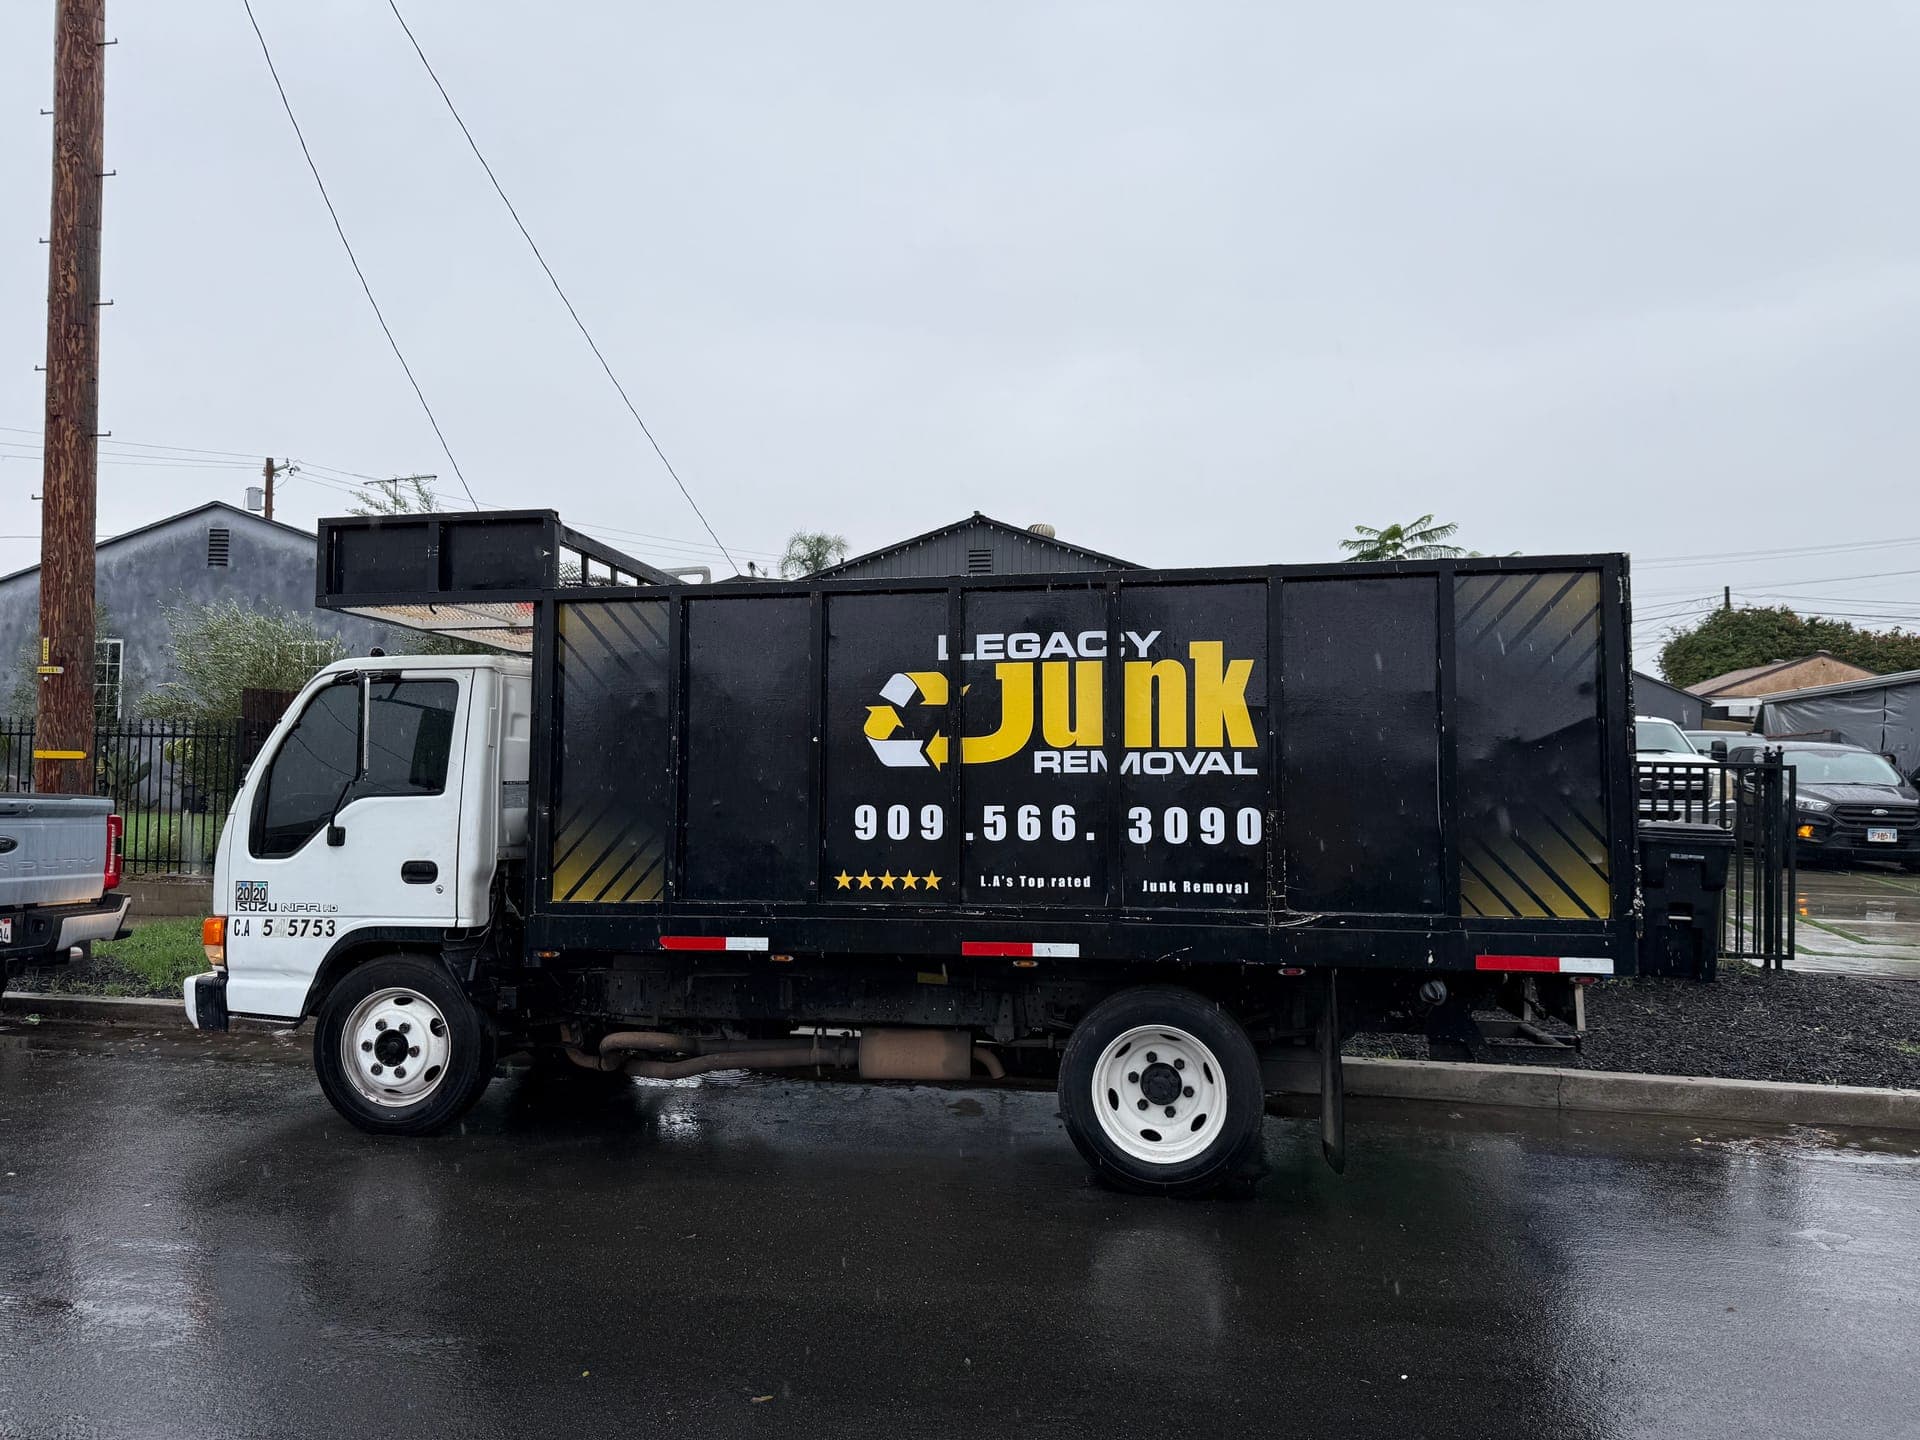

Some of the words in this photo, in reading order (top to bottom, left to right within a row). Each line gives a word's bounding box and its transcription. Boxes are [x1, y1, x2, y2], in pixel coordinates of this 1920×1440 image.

[937, 630, 1162, 661] LEGACY
[961, 641, 1258, 764] Junk
[1033, 750, 1258, 776] REMOVAL
[1127, 806, 1262, 846] 3090
[980, 875, 1014, 888] L.A's
[1019, 875, 1045, 889] Top
[1050, 875, 1092, 888] rated
[1142, 879, 1177, 893] Junk
[1183, 880, 1249, 895] Removal
[235, 901, 277, 912] ISUZU
[281, 903, 321, 912] NPR
